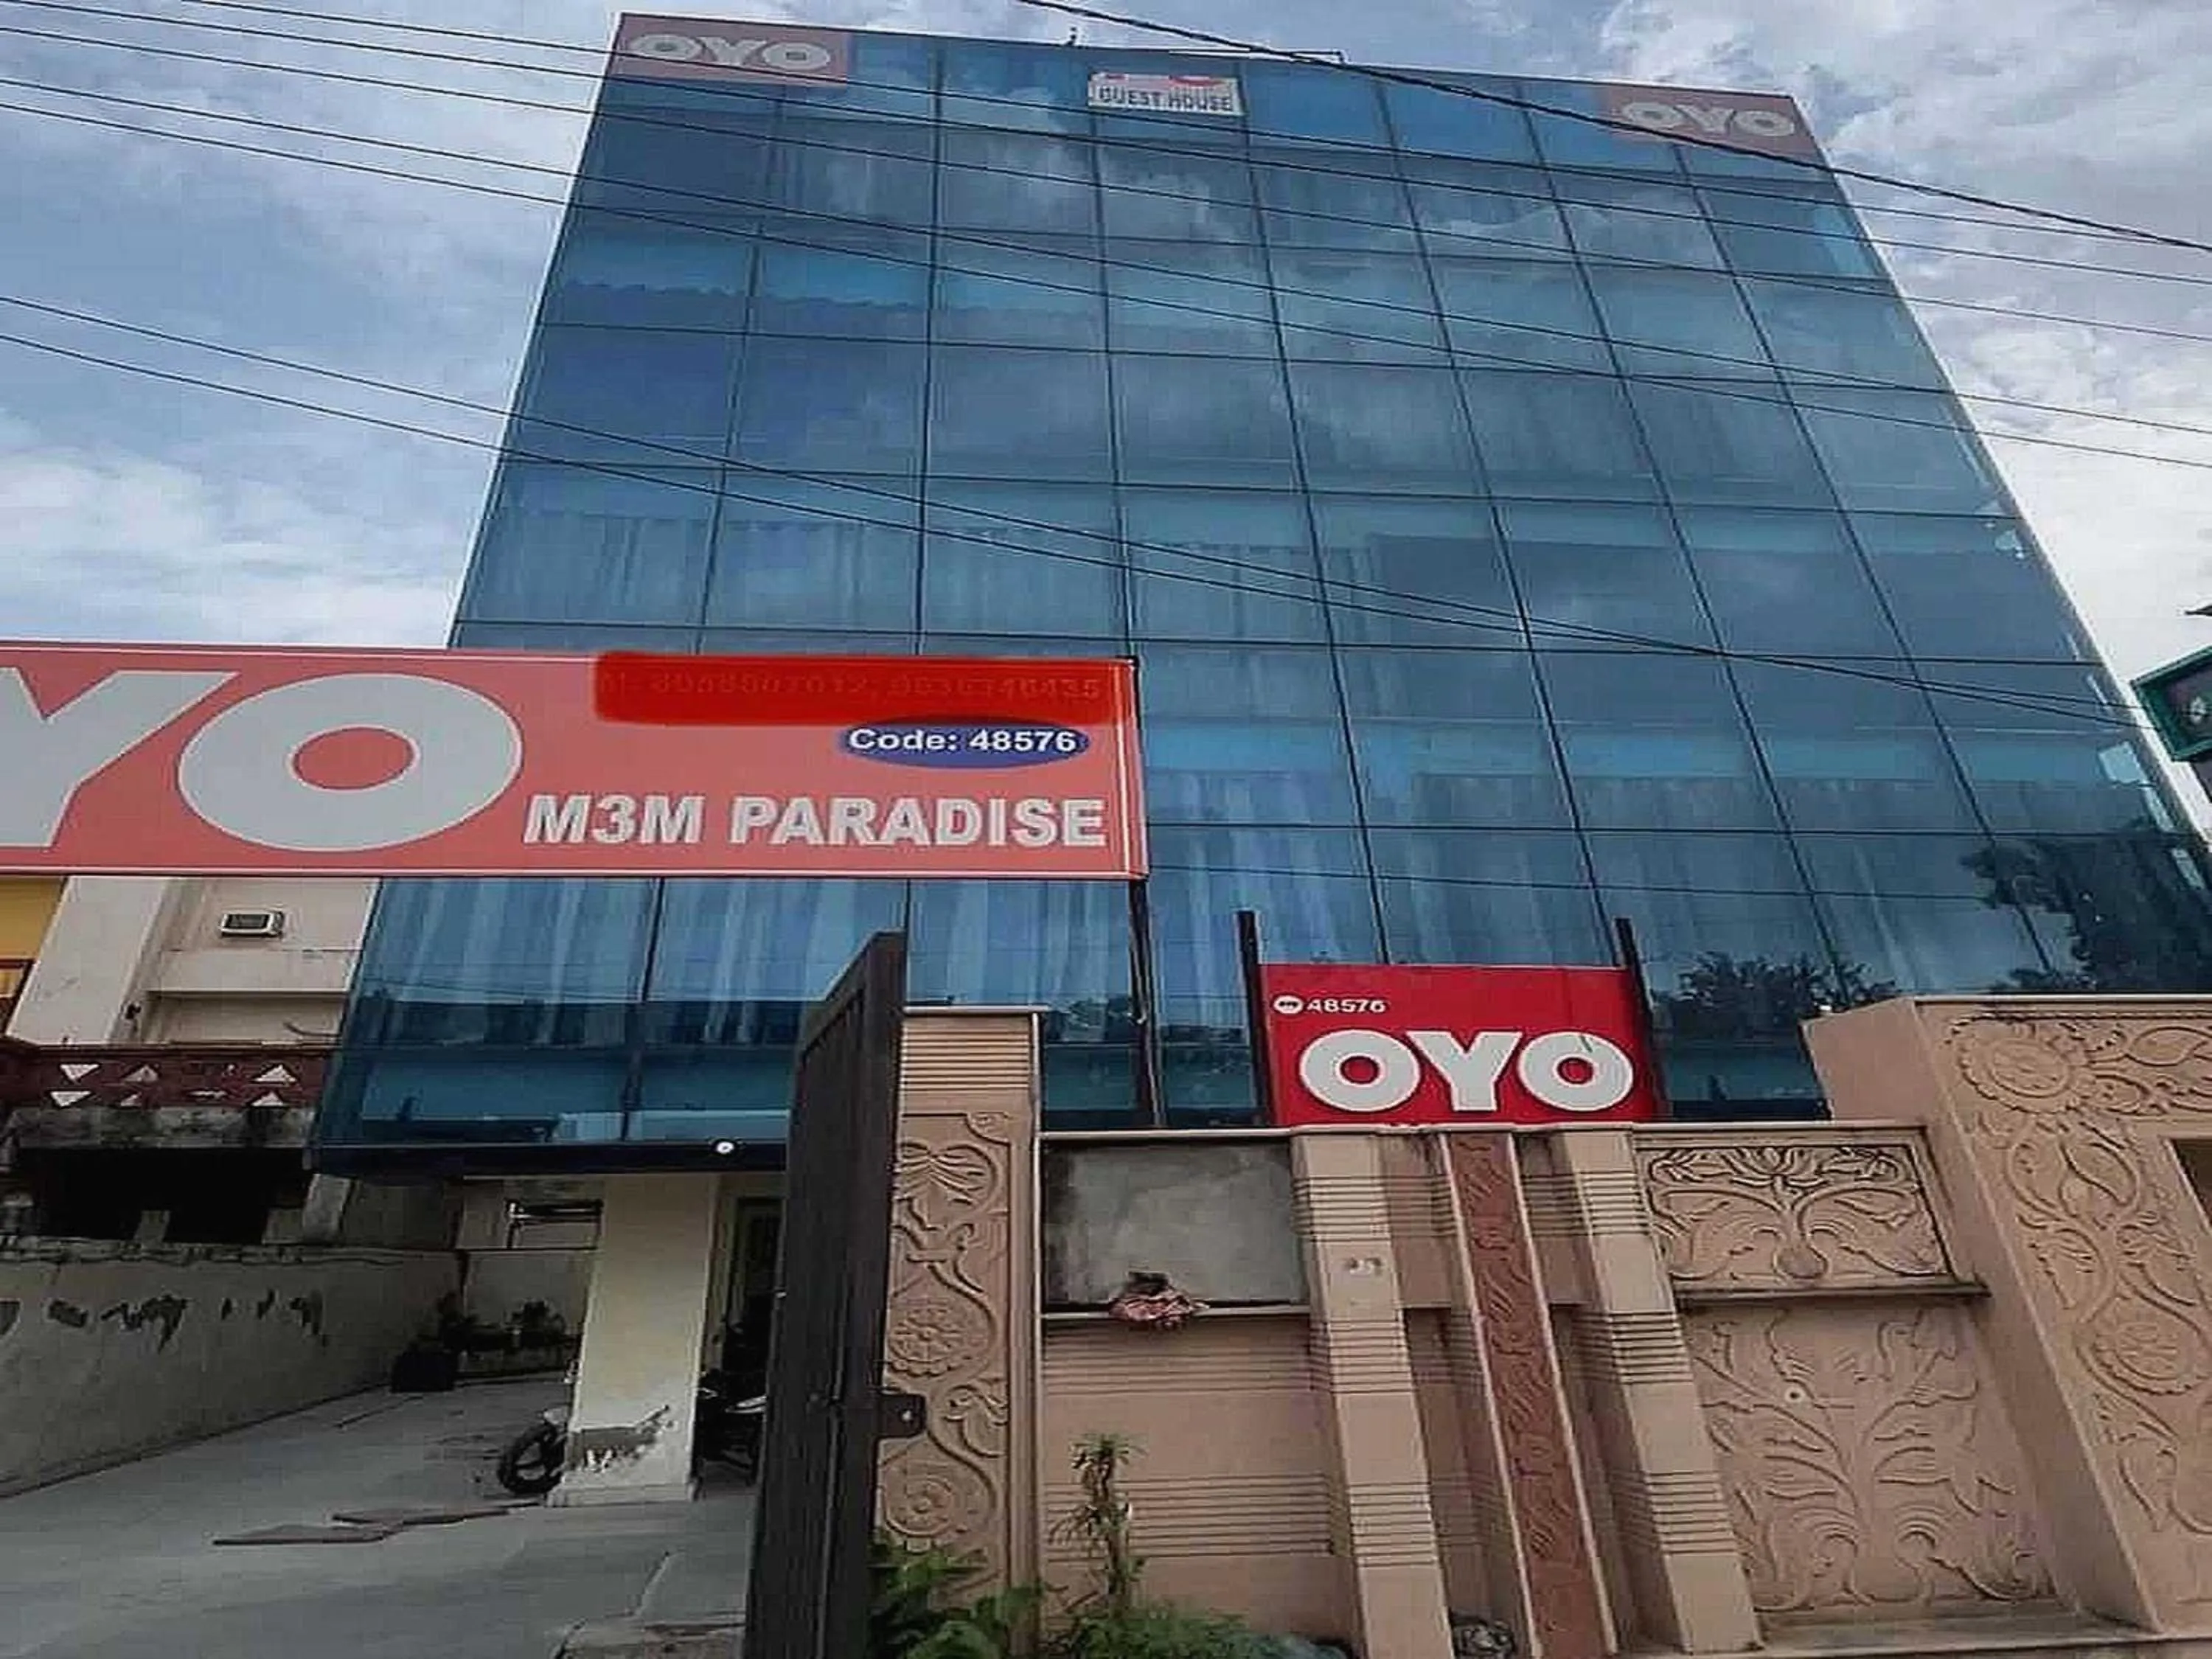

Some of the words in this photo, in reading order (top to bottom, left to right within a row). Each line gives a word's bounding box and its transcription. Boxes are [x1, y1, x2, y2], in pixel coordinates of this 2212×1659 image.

[627, 34, 832, 71] OYO
[1098, 85, 1161, 107] GUEST
[1167, 91, 1234, 111] HOUSE
[1622, 102, 1795, 137] OYO
[849, 727, 958, 751] Code:
[968, 728, 1077, 752] 48576
[523, 793, 706, 845] M3M
[729, 796, 1106, 846] PARADISE
[1299, 1029, 1634, 1113] OYO
